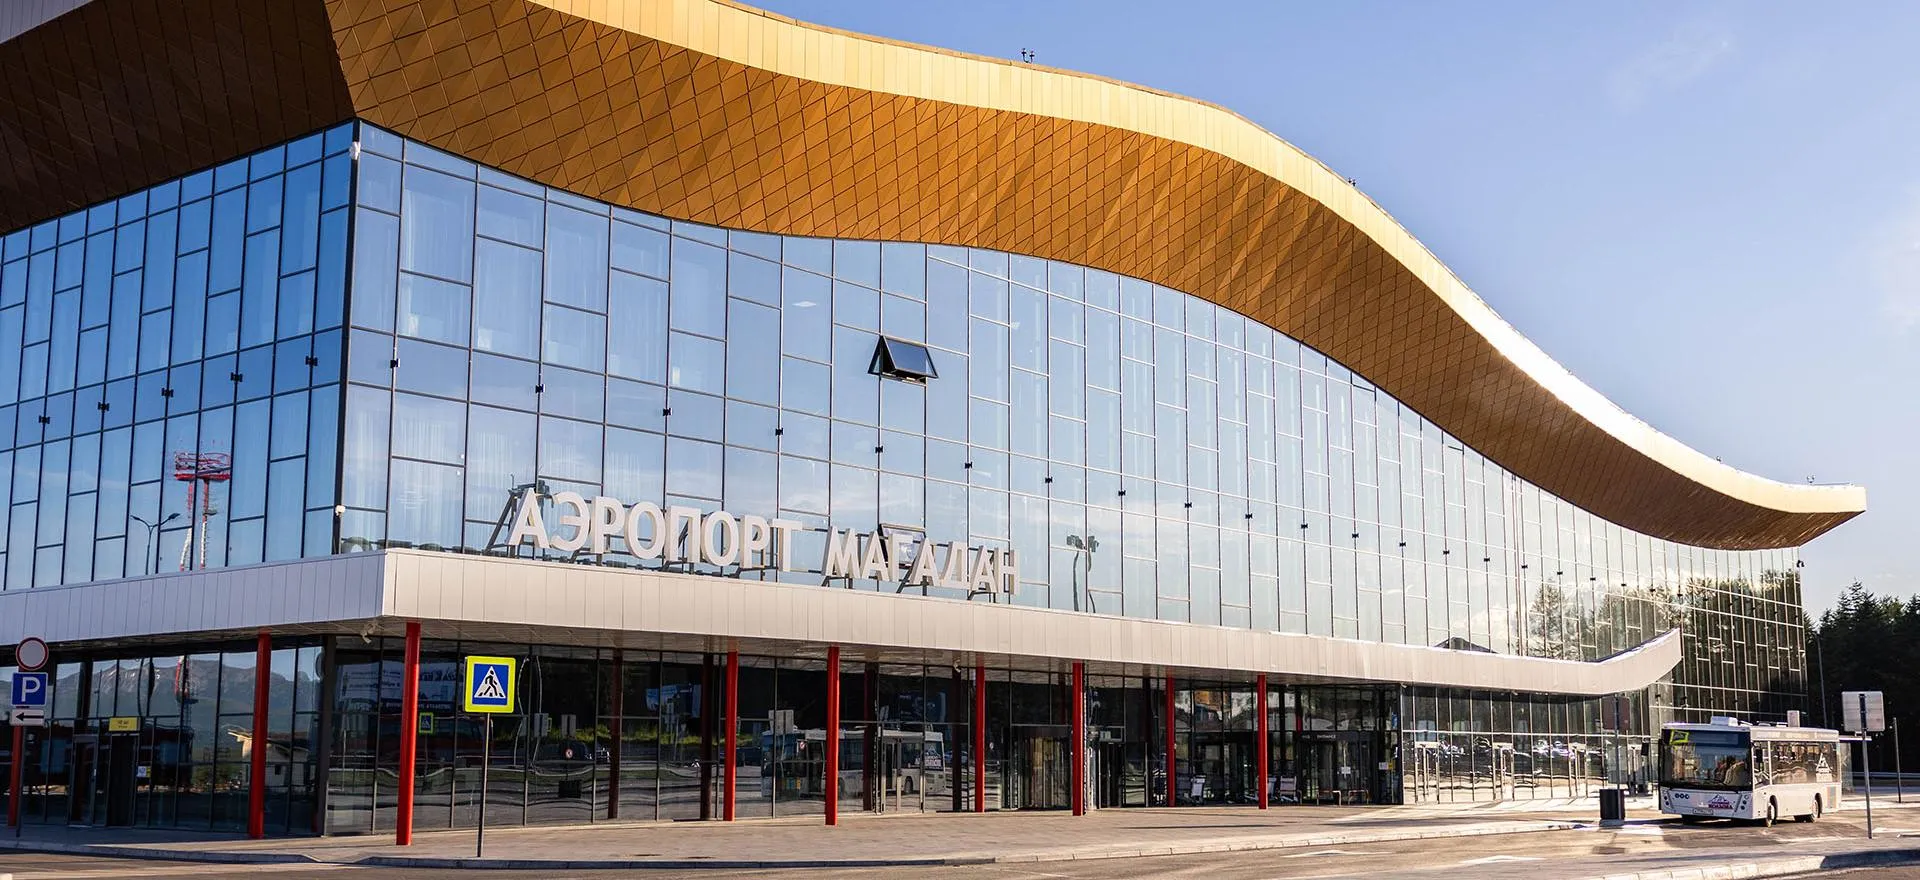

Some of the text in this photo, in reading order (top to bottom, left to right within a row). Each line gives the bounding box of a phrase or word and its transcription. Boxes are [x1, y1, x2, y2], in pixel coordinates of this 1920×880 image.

[506, 488, 1020, 595] АЭРОПОРТ МАГАДАН
[21, 676, 40, 702] P
